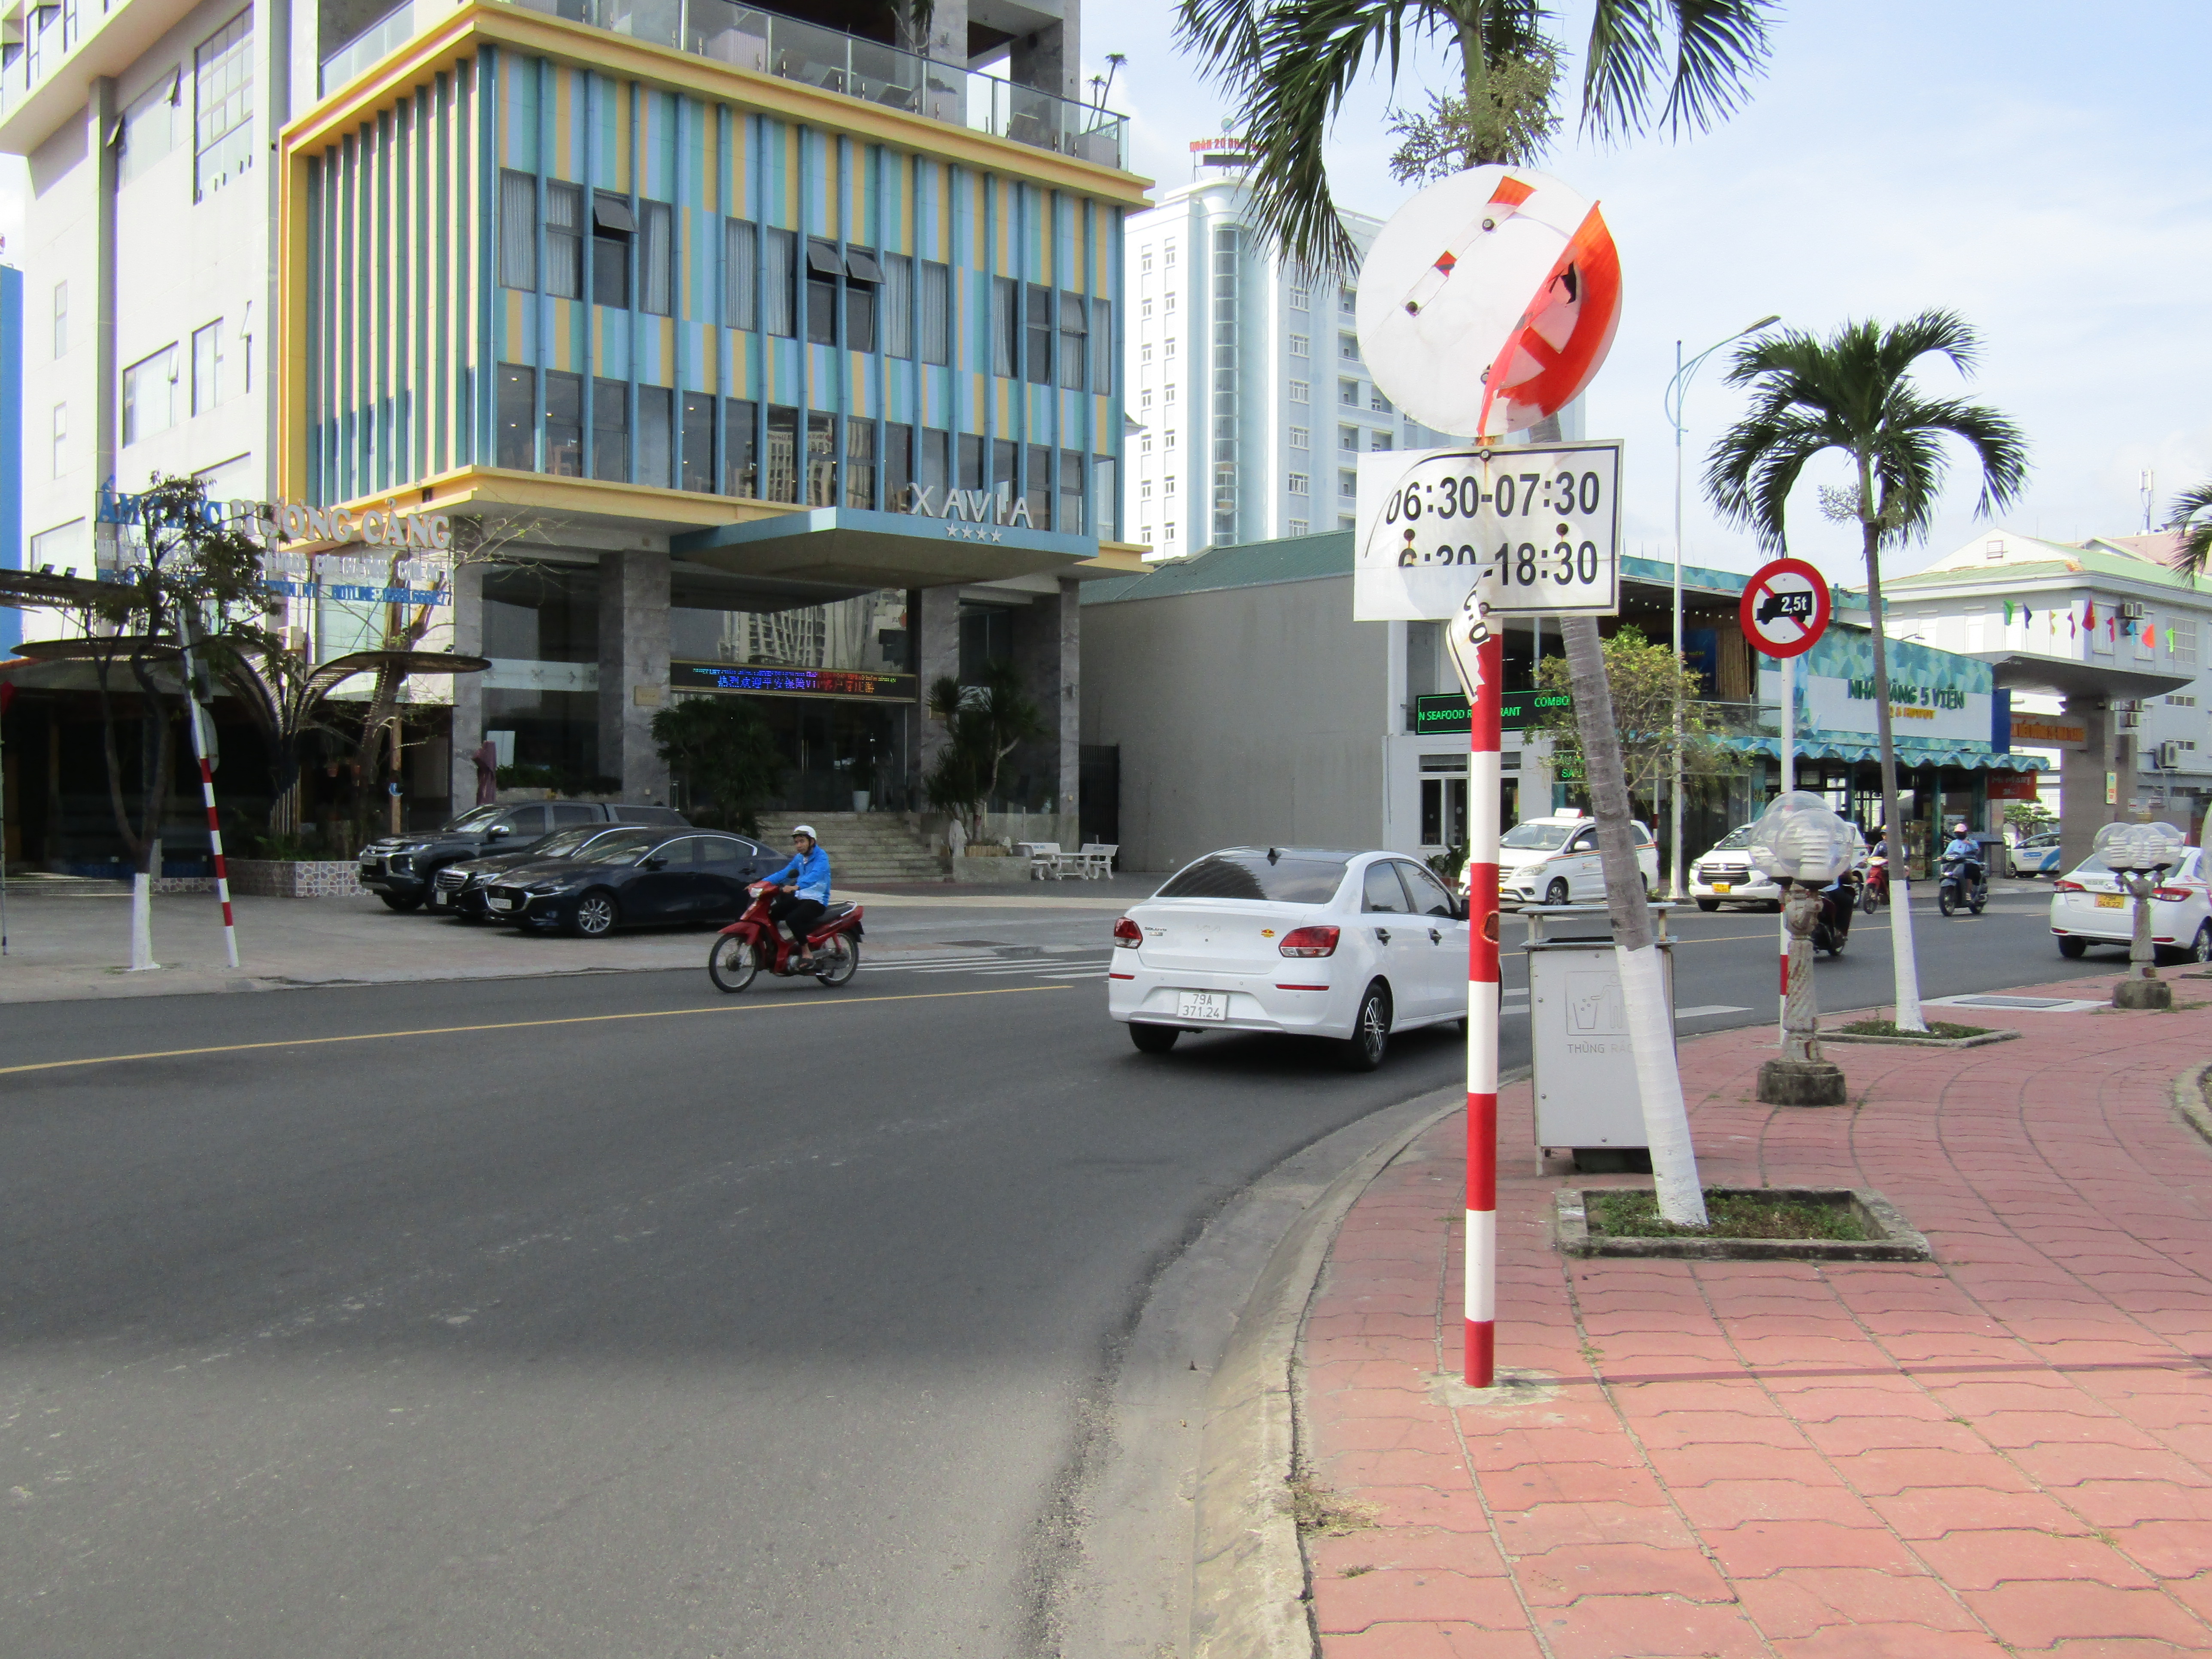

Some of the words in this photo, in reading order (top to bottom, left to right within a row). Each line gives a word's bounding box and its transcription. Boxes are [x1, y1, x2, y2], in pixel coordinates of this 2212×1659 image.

[911, 482, 1034, 529] XAVIA
[1385, 471, 1599, 525] 06:30-07:30
[362, 497, 452, 549] CẢNG
[1781, 596, 1807, 614] 2,5t
[1887, 678, 1918, 704] ÀNG
[1921, 687, 1929, 705] 5
[1534, 696, 1570, 708] COMBO
[1427, 709, 1465, 720] SEAFOOD
[1193, 994, 1212, 1005] 79A
[1182, 1005, 1219, 1018] 371.24
[1567, 1040, 1604, 1053] THÙNG
